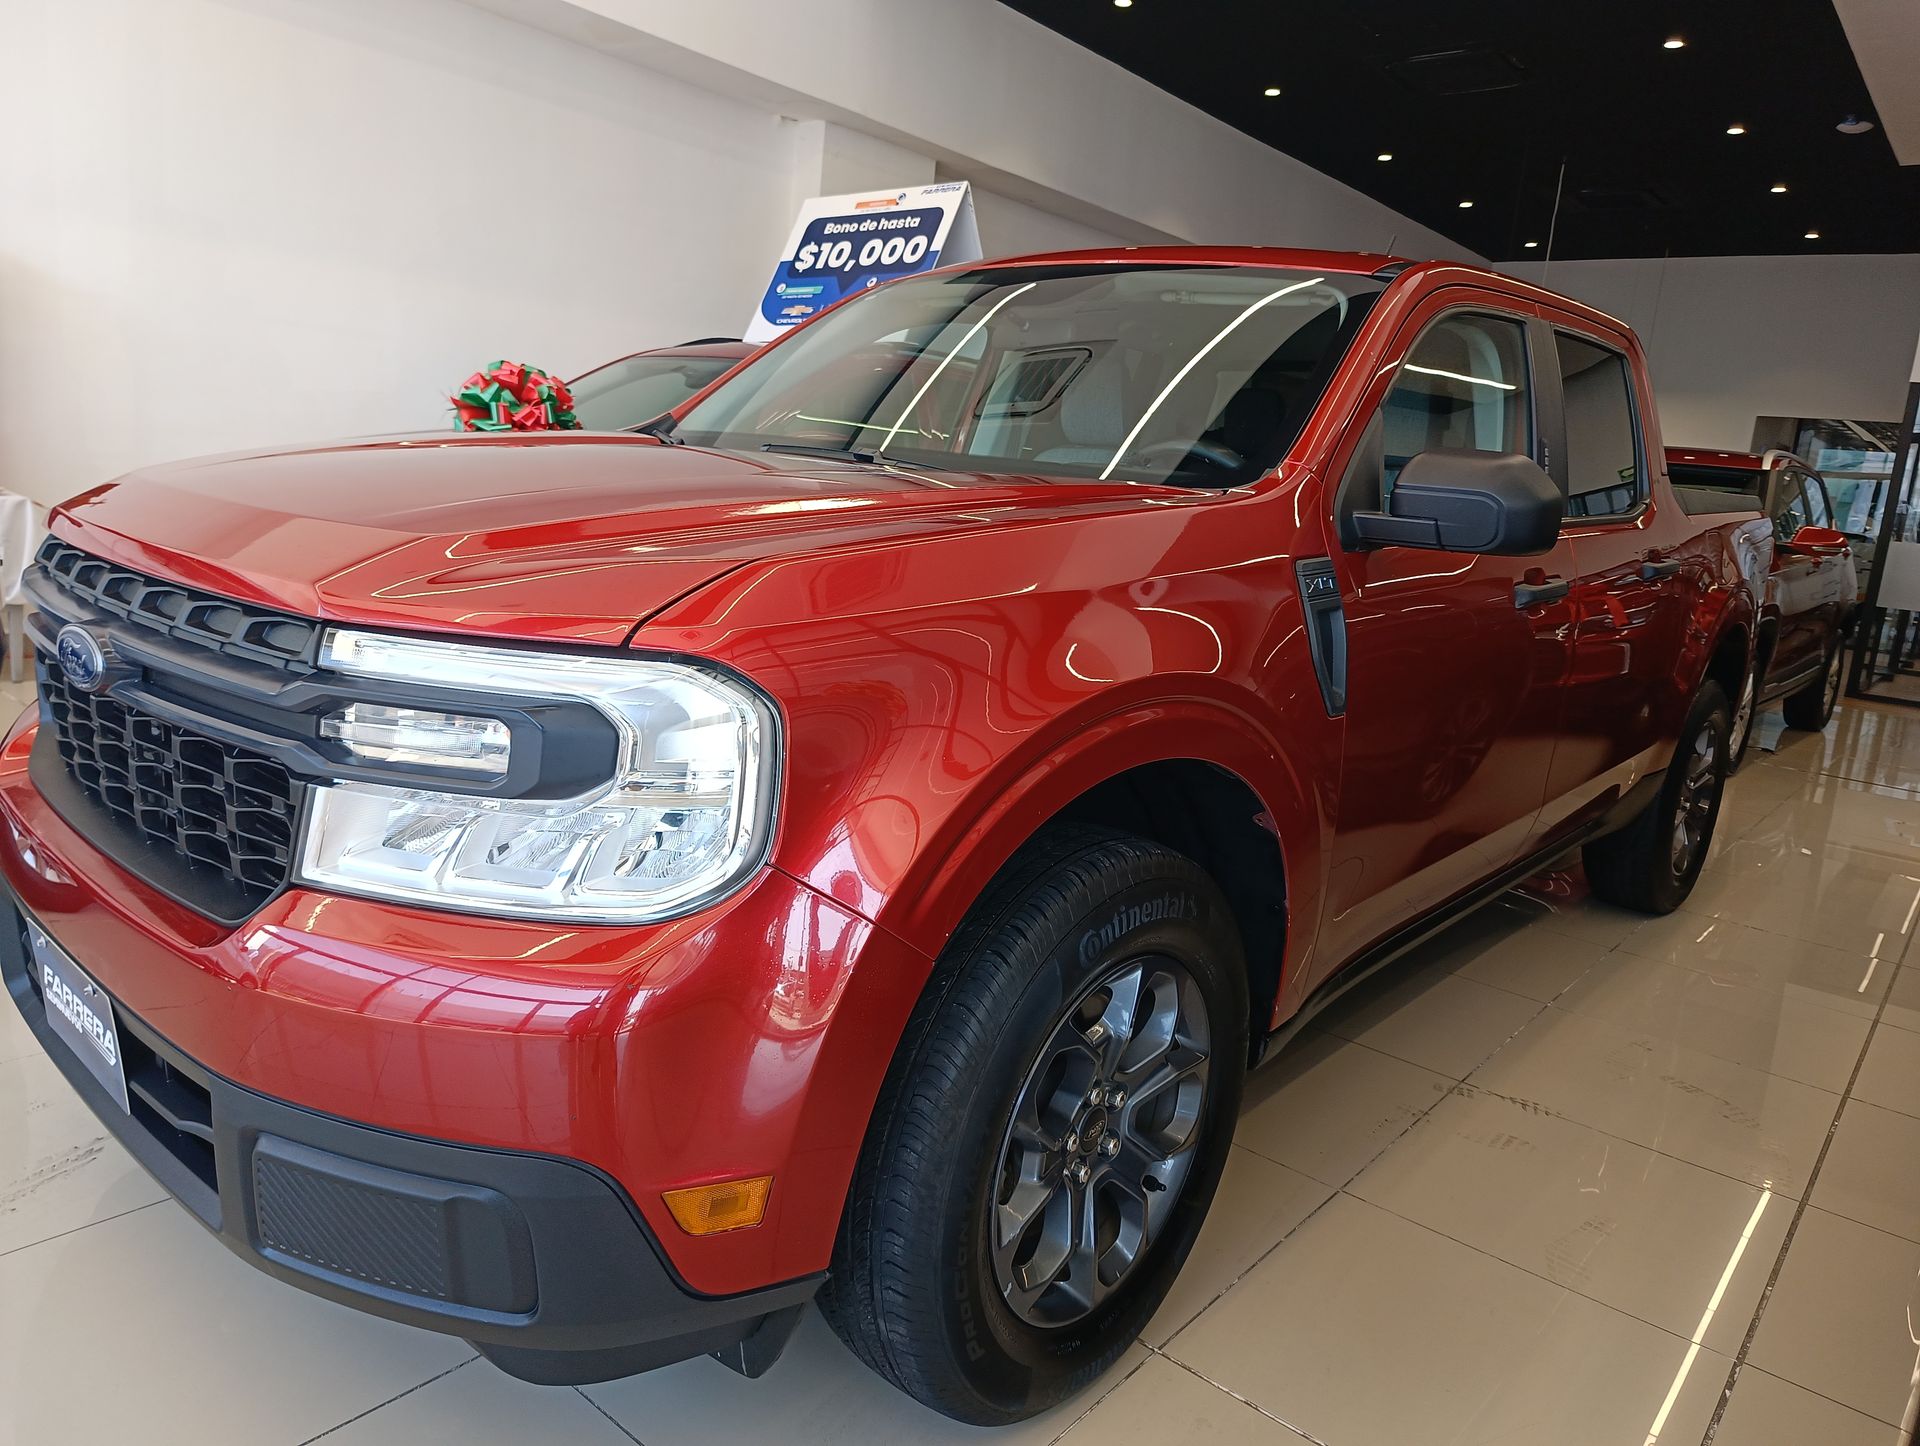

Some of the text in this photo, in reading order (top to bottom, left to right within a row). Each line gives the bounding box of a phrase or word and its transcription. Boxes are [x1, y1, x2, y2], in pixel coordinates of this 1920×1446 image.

[823, 216, 921, 236] Bono de hasta
[794, 235, 929, 273] $10,000
[60, 638, 88, 676] Ford
[1079, 891, 1185, 968] Continental
[44, 964, 116, 1057] FARRERA
